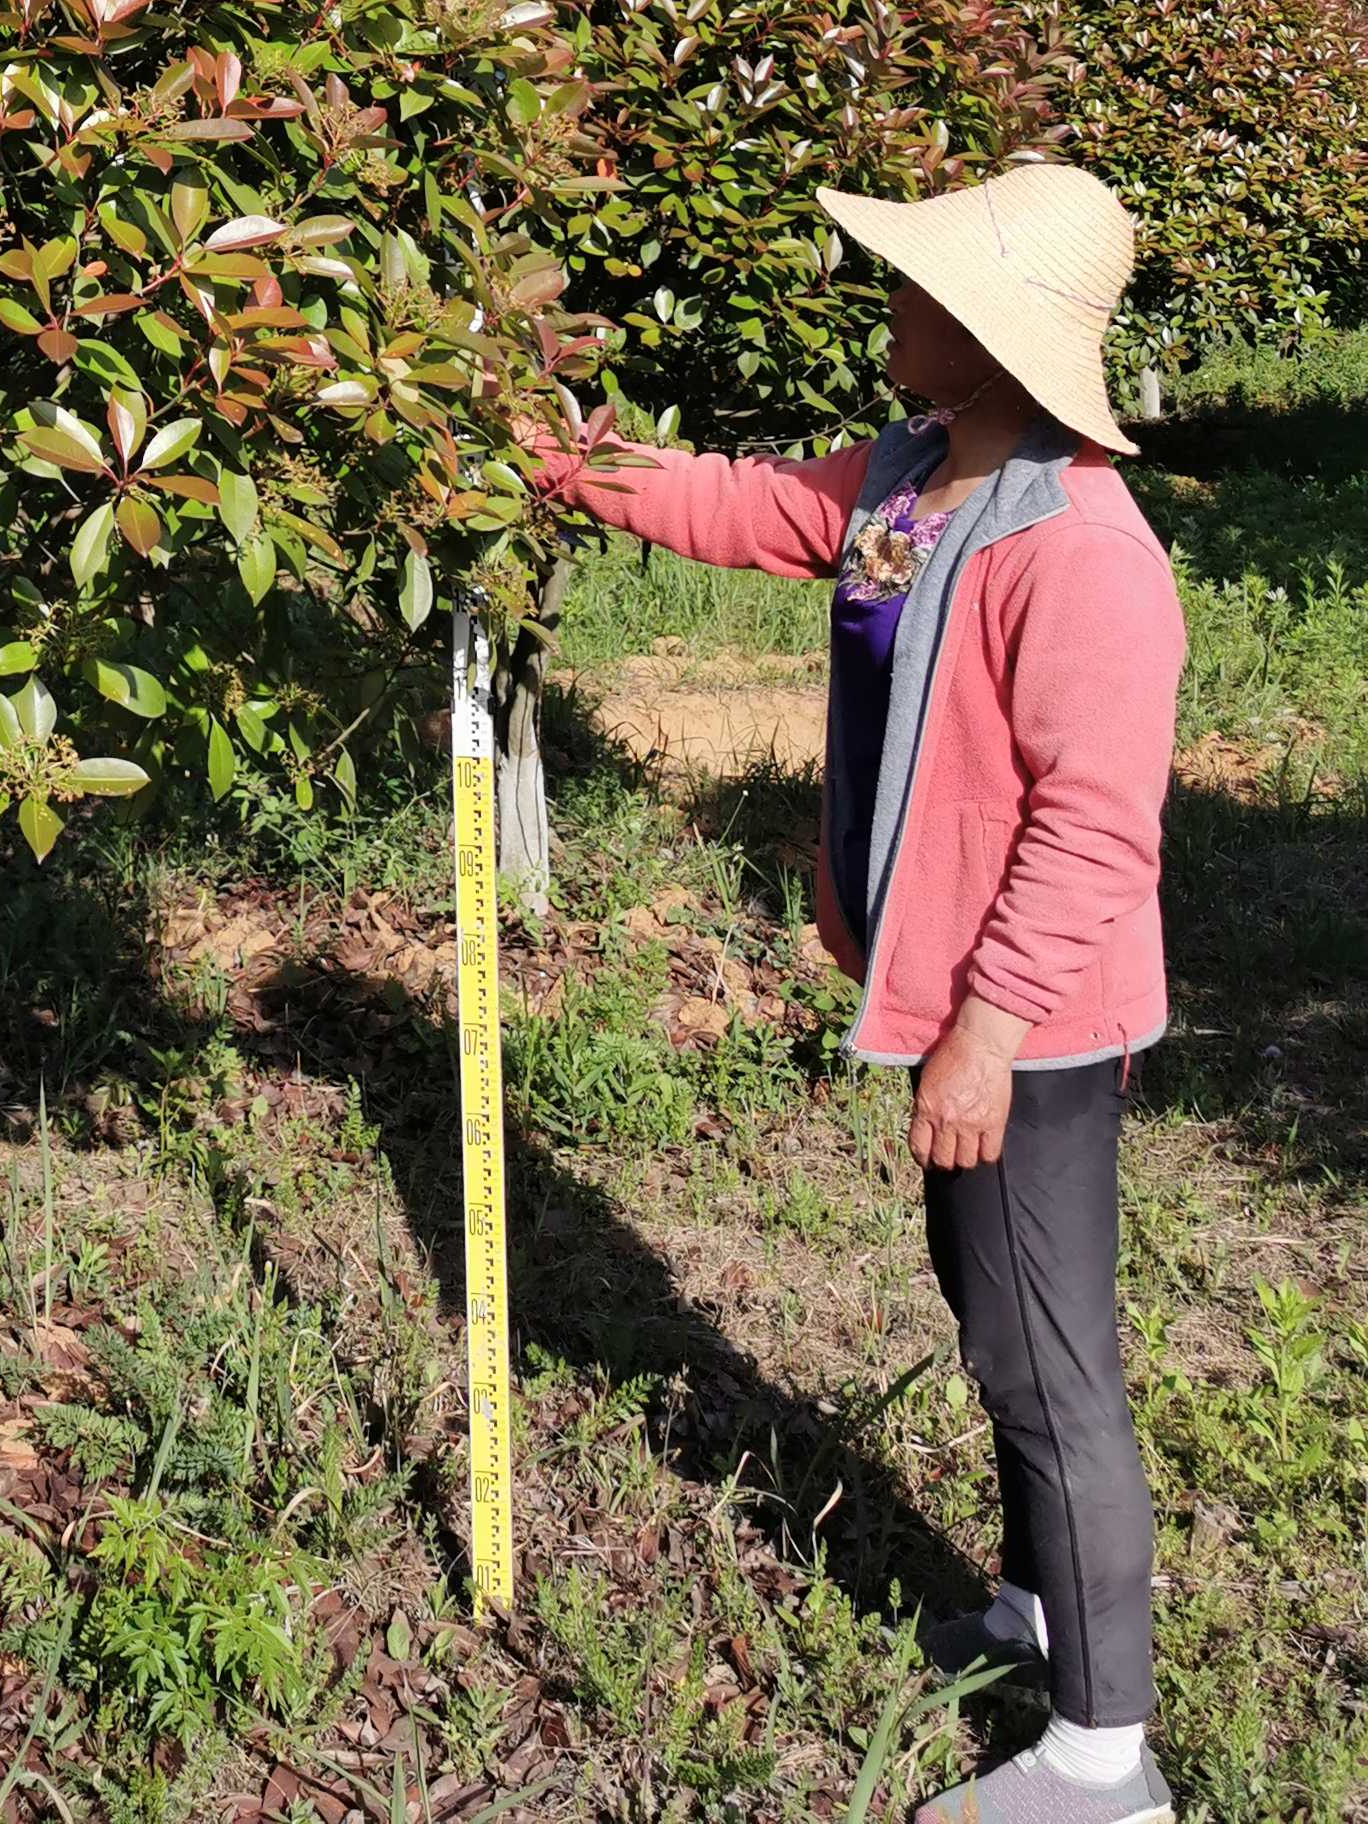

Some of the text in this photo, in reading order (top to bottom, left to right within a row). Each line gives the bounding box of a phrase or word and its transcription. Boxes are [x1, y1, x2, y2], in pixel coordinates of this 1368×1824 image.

[457, 762, 471, 788] 10
[459, 850, 473, 877] 09
[461, 939, 476, 966] 08
[464, 1029, 478, 1056] 07
[467, 1119, 481, 1146] 06
[468, 1209, 483, 1236] 05
[475, 1476, 489, 1503] 02
